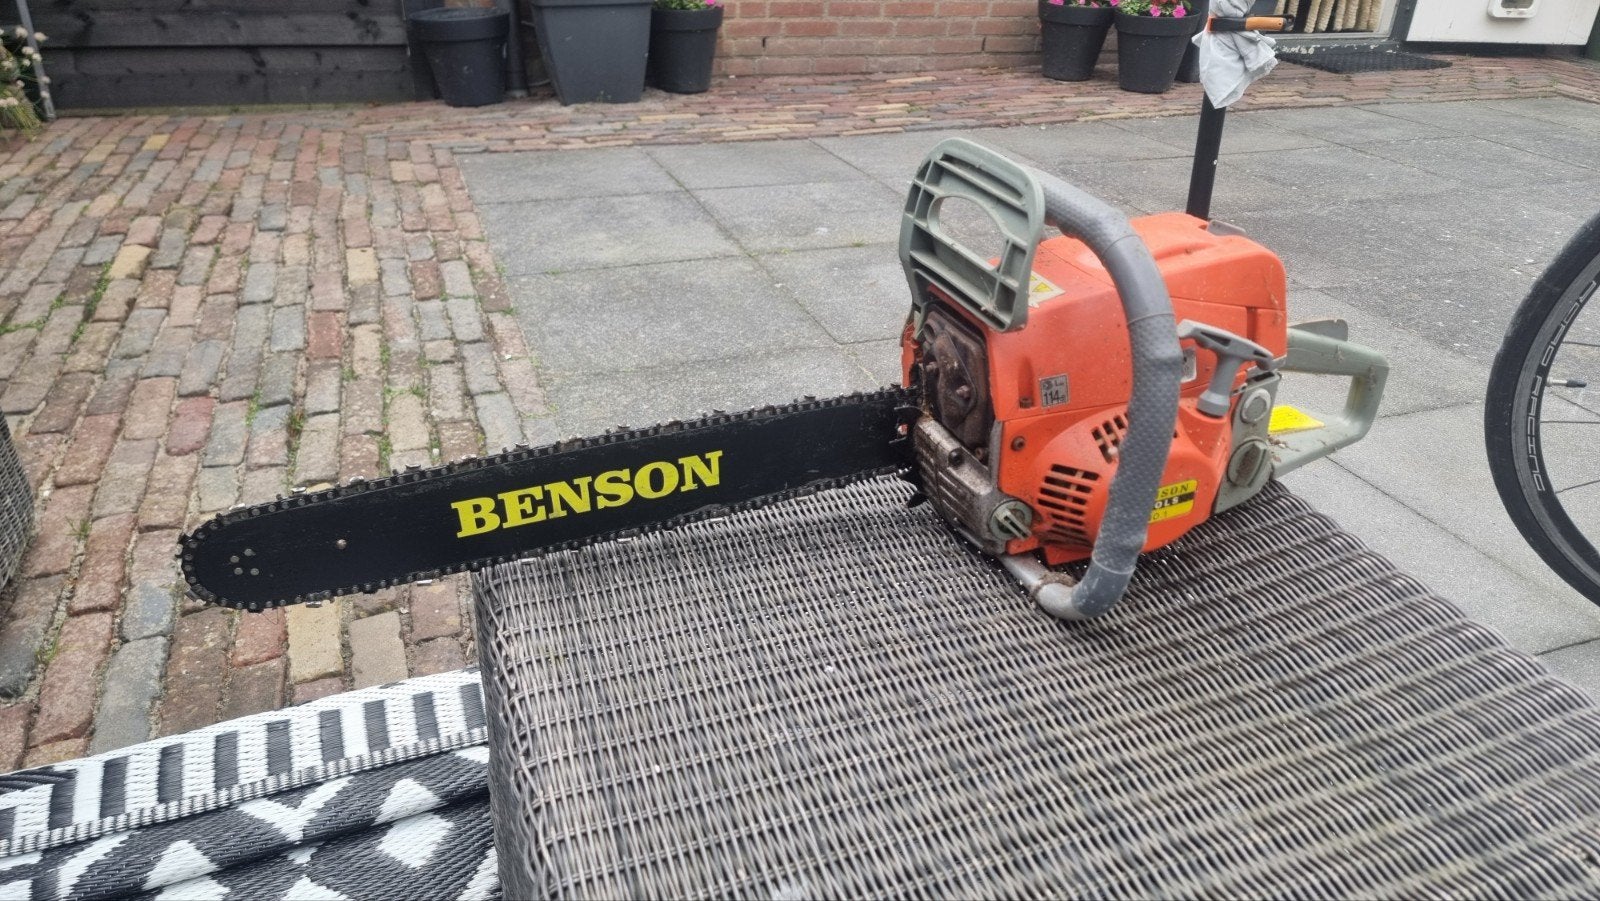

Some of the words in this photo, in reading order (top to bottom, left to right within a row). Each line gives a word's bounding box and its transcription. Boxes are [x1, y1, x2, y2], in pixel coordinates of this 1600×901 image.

[1541, 280, 1597, 367] ROAD
[1527, 375, 1545, 492] RACING
[450, 450, 723, 538] BENSON
[1154, 496, 1180, 509] OLS
[1160, 483, 1189, 498] SON
